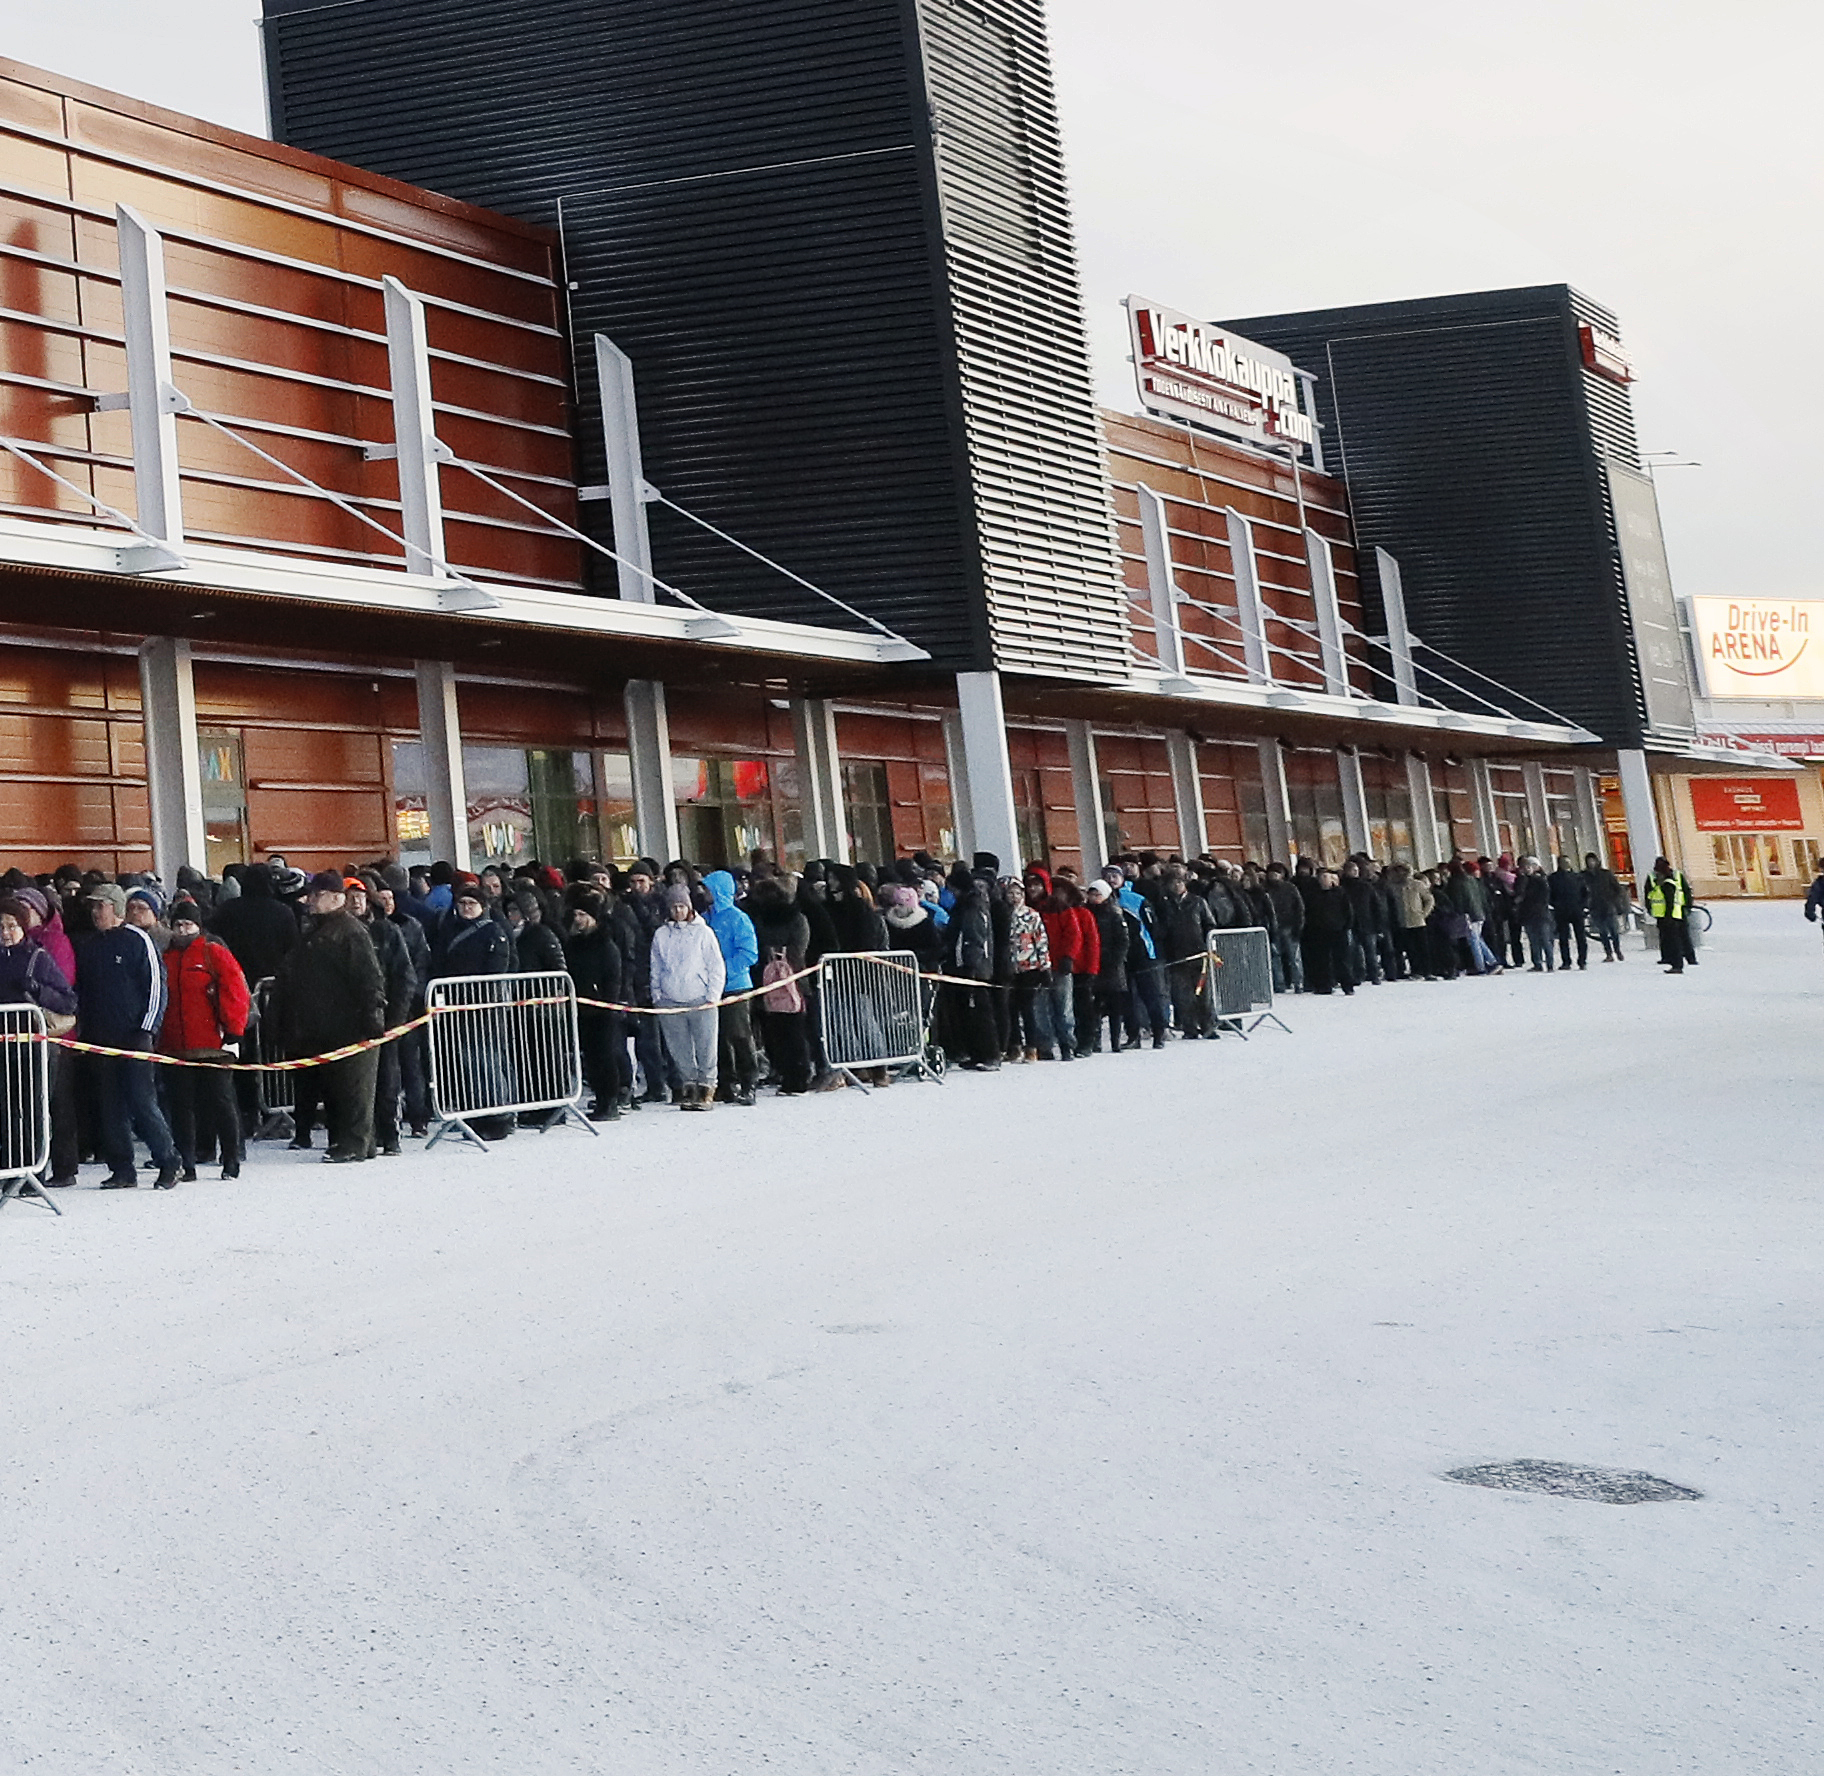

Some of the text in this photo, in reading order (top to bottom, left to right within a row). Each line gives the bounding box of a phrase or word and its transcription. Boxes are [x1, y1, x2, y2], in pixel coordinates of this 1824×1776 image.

[1147, 308, 1298, 415] Verkkokauppa
[1728, 603, 1809, 633] Drive-In
[1712, 632, 1783, 660] ARENA
